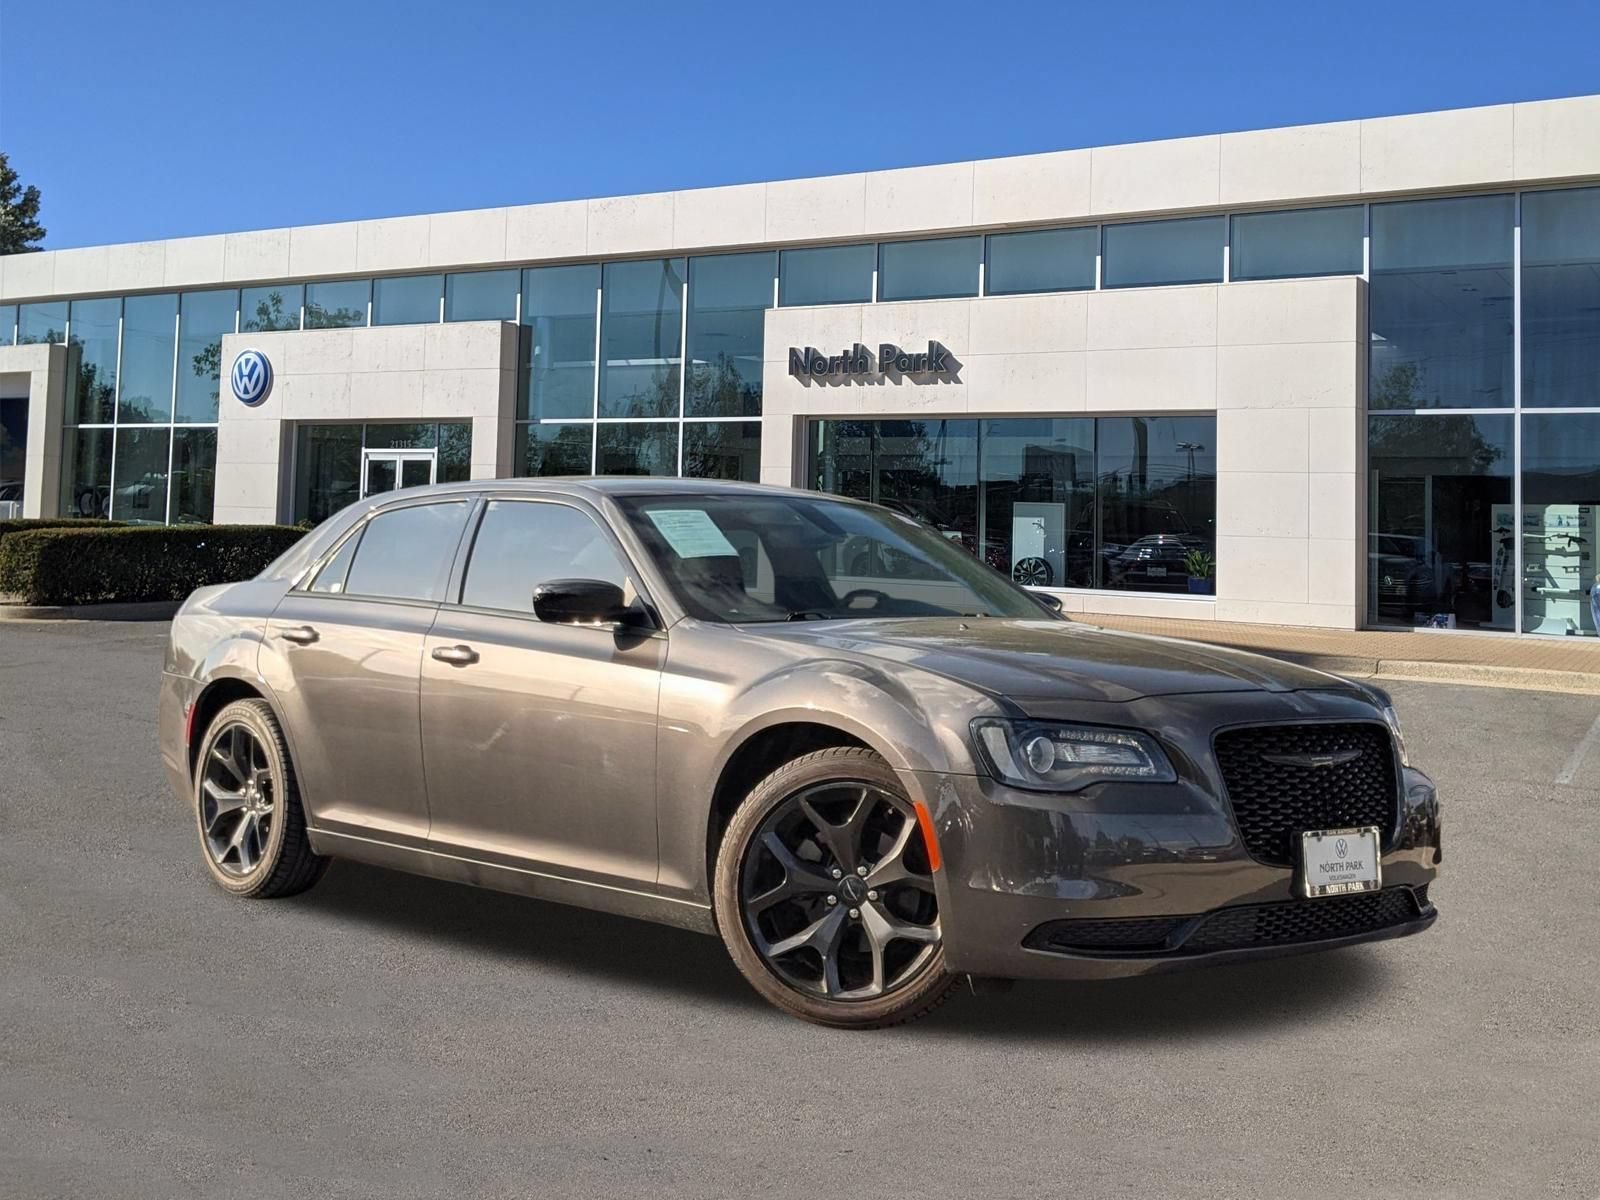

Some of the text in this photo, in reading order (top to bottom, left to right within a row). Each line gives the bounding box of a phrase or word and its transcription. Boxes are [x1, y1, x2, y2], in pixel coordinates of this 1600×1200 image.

[789, 340, 947, 376] North Park
[390, 439, 412, 449] 21315
[1320, 861, 1364, 873] NORTH PARK
[1329, 873, 1356, 881] VOLKSWAGEN
[1326, 881, 1364, 893] NORTH PARK
